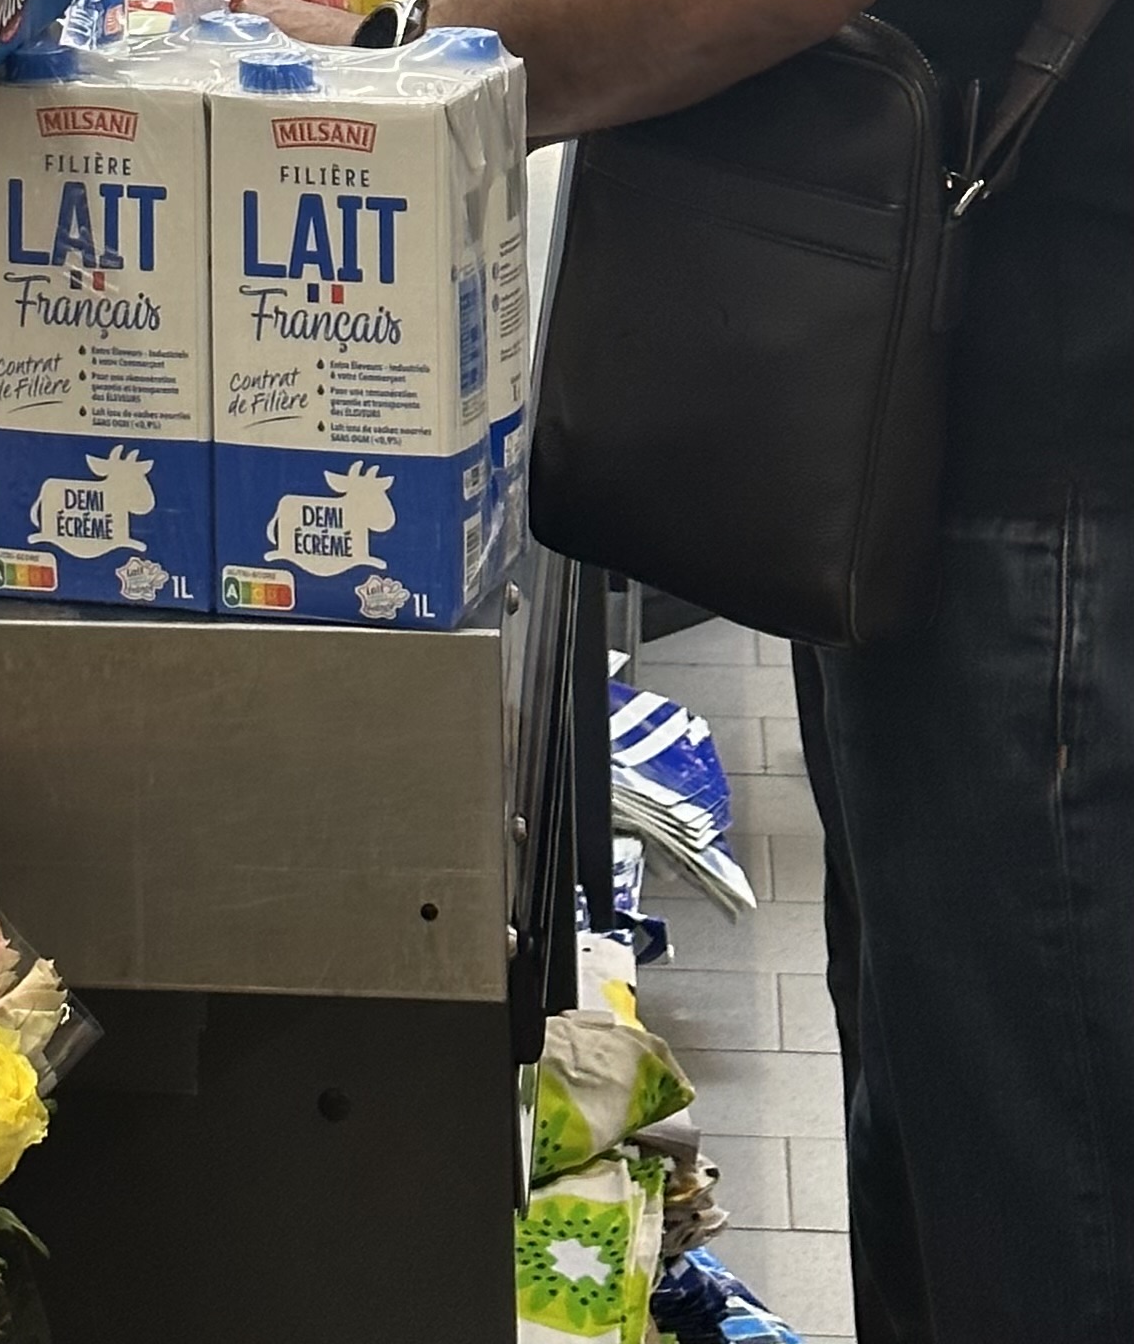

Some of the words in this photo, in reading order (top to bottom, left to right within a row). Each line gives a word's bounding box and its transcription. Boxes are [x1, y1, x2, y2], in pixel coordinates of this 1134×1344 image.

[43, 112, 130, 136] MILSANI
[279, 123, 370, 148] MILSANI
[45, 152, 132, 177] FILIÈRE
[280, 164, 370, 188] FILIÈRE
[8, 178, 167, 272] LAIT
[243, 190, 408, 284] LAIT
[4, 272, 160, 339] Français
[239, 284, 401, 353] Français
[14, 375, 72, 399] Filière
[229, 367, 300, 393] Contrat
[228, 393, 247, 415] de
[249, 390, 308, 415] Filière
[65, 488, 104, 511] DEMI
[57, 511, 114, 540] ÉCRÉMÉ
[302, 505, 343, 529] DEMI
[294, 528, 353, 558] ÉCRÉMÉ
[172, 575, 194, 599] 1L
[413, 593, 436, 618] 1L
